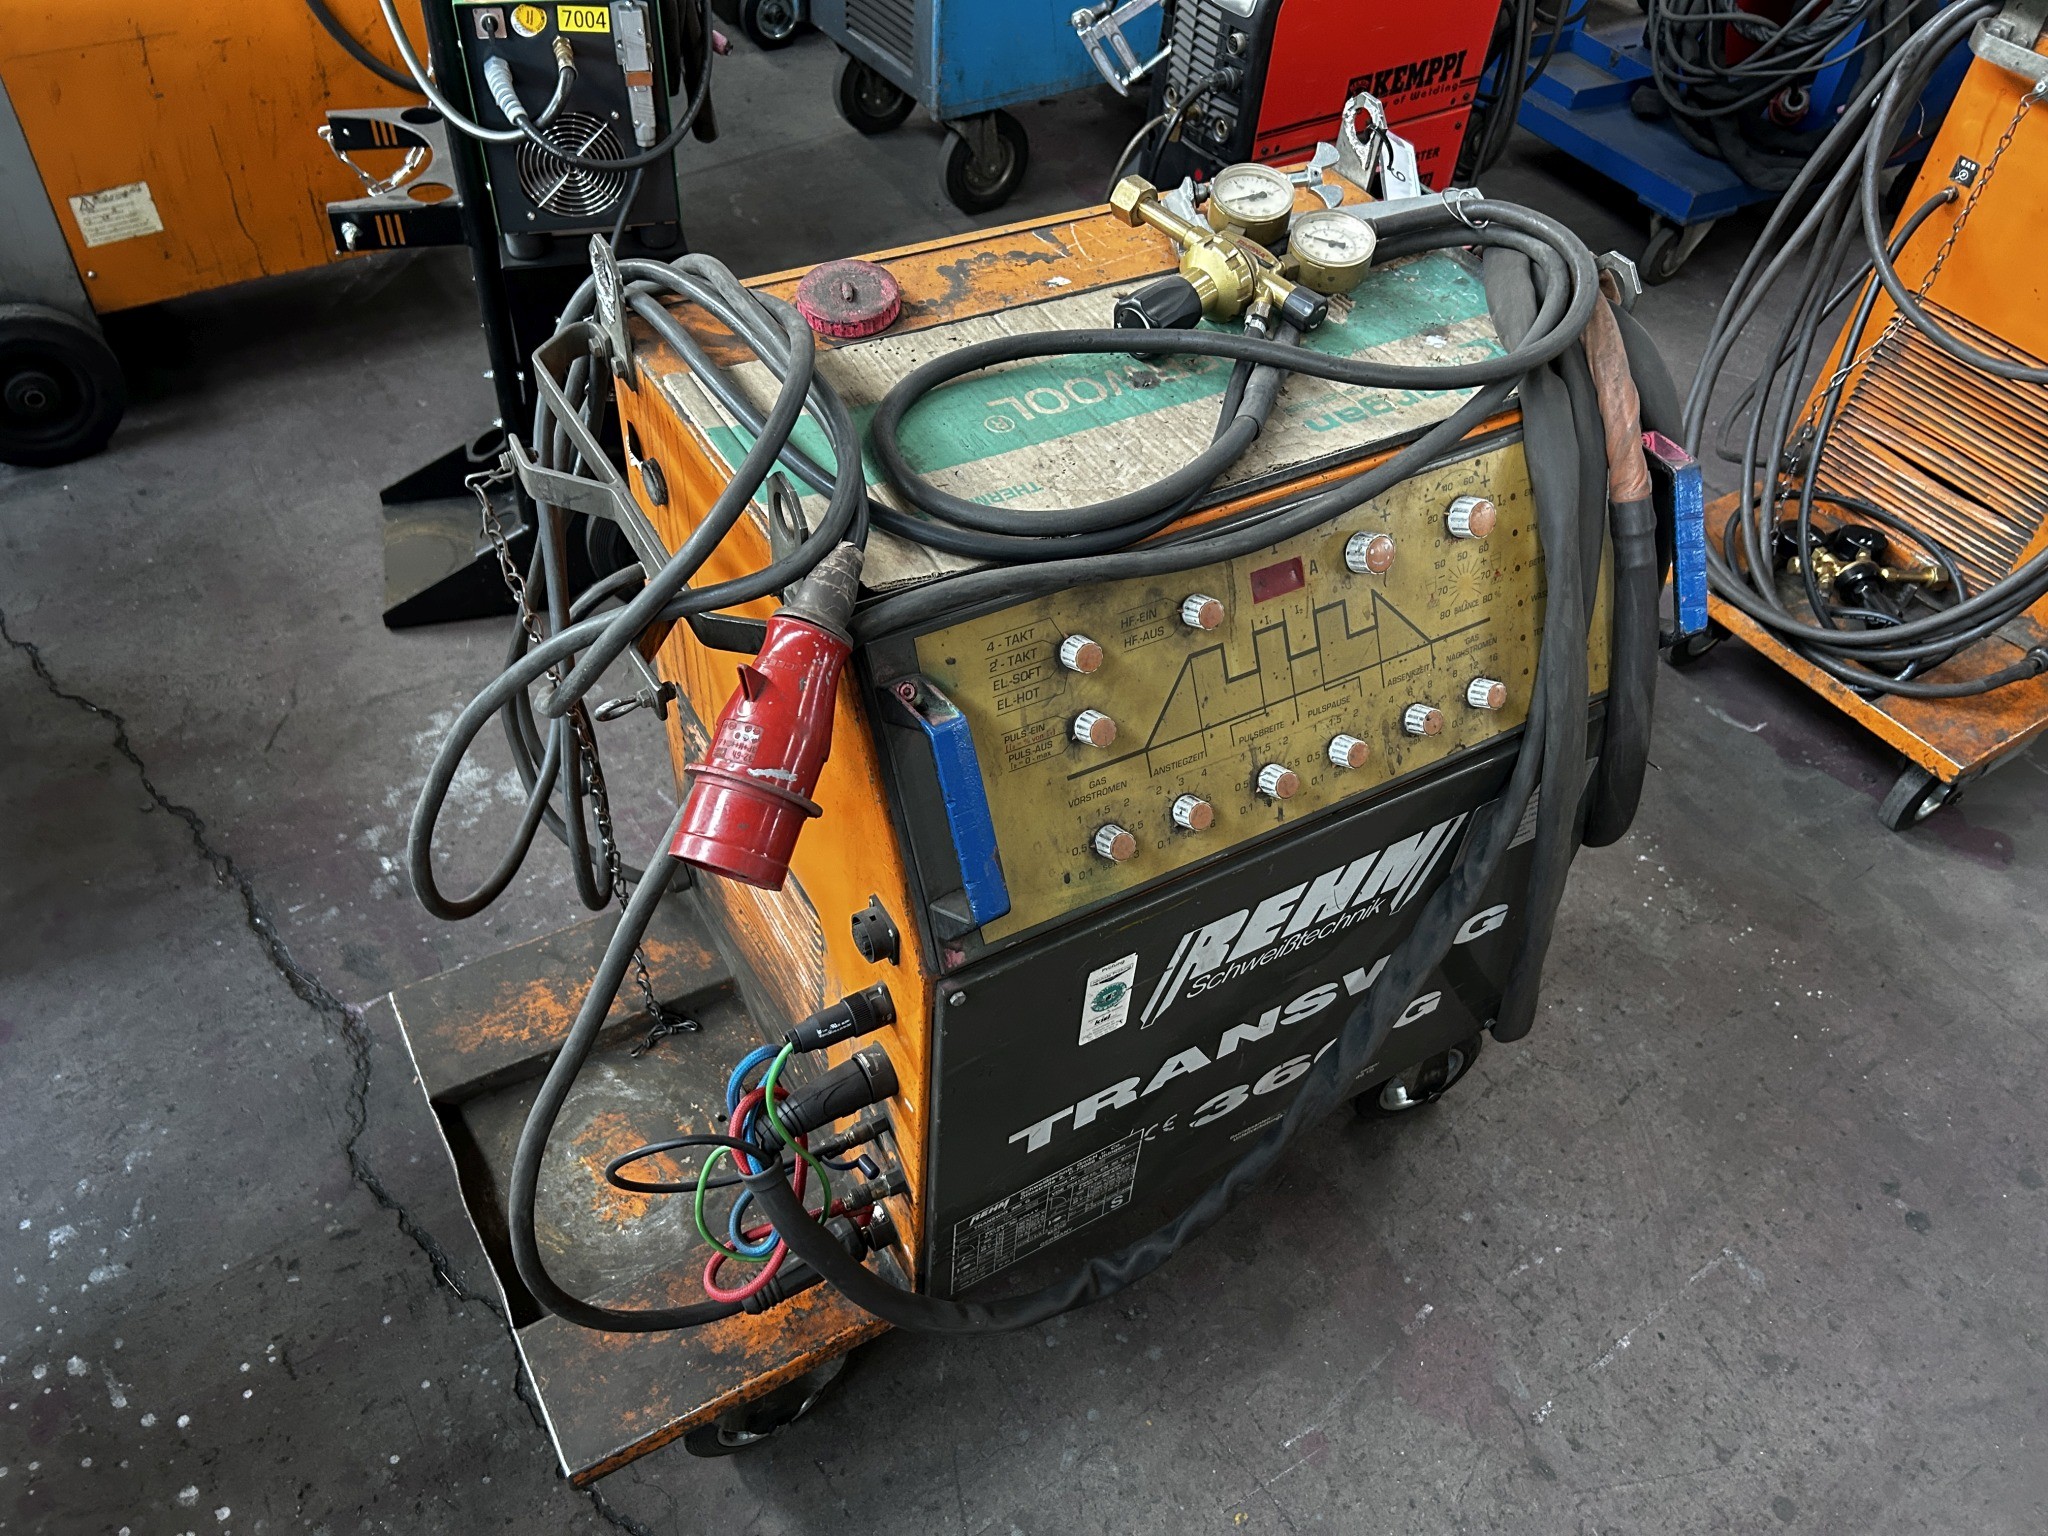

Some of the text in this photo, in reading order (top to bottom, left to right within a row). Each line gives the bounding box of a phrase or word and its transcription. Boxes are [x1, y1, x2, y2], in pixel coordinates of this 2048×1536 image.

[561, 10, 607, 29] 7004
[1372, 49, 1468, 98] KEMPPI
[1410, 83, 1458, 101] Welding
[1463, 475, 1474, 486] 60
[1427, 514, 1438, 525] 20
[1457, 551, 1468, 561] 50
[1478, 543, 1489, 554] 60
[1309, 559, 1318, 575] A
[1434, 559, 1446, 569] 60
[1481, 570, 1491, 580] 70
[1437, 585, 1448, 596] 70
[1440, 609, 1450, 620] 80
[1454, 599, 1479, 615] BALANCE
[1482, 593, 1493, 604] 80
[1004, 628, 1035, 647] TAKT
[1124, 626, 1165, 649] HF.-AUS
[1465, 634, 1479, 645] GAS
[1008, 648, 1038, 666] TAKT
[1469, 661, 1479, 671] 12
[1387, 663, 1430, 687] ABSENKZEIT
[1307, 695, 1351, 718] PULSPAUSE
[1238, 721, 1285, 745] PULSBREITE
[1153, 751, 1205, 776] ANSTIEGZEIT
[1088, 777, 1107, 790] GAS
[1186, 897, 1386, 999] Schweißtechnik
[1110, 1195, 1124, 1209] S
